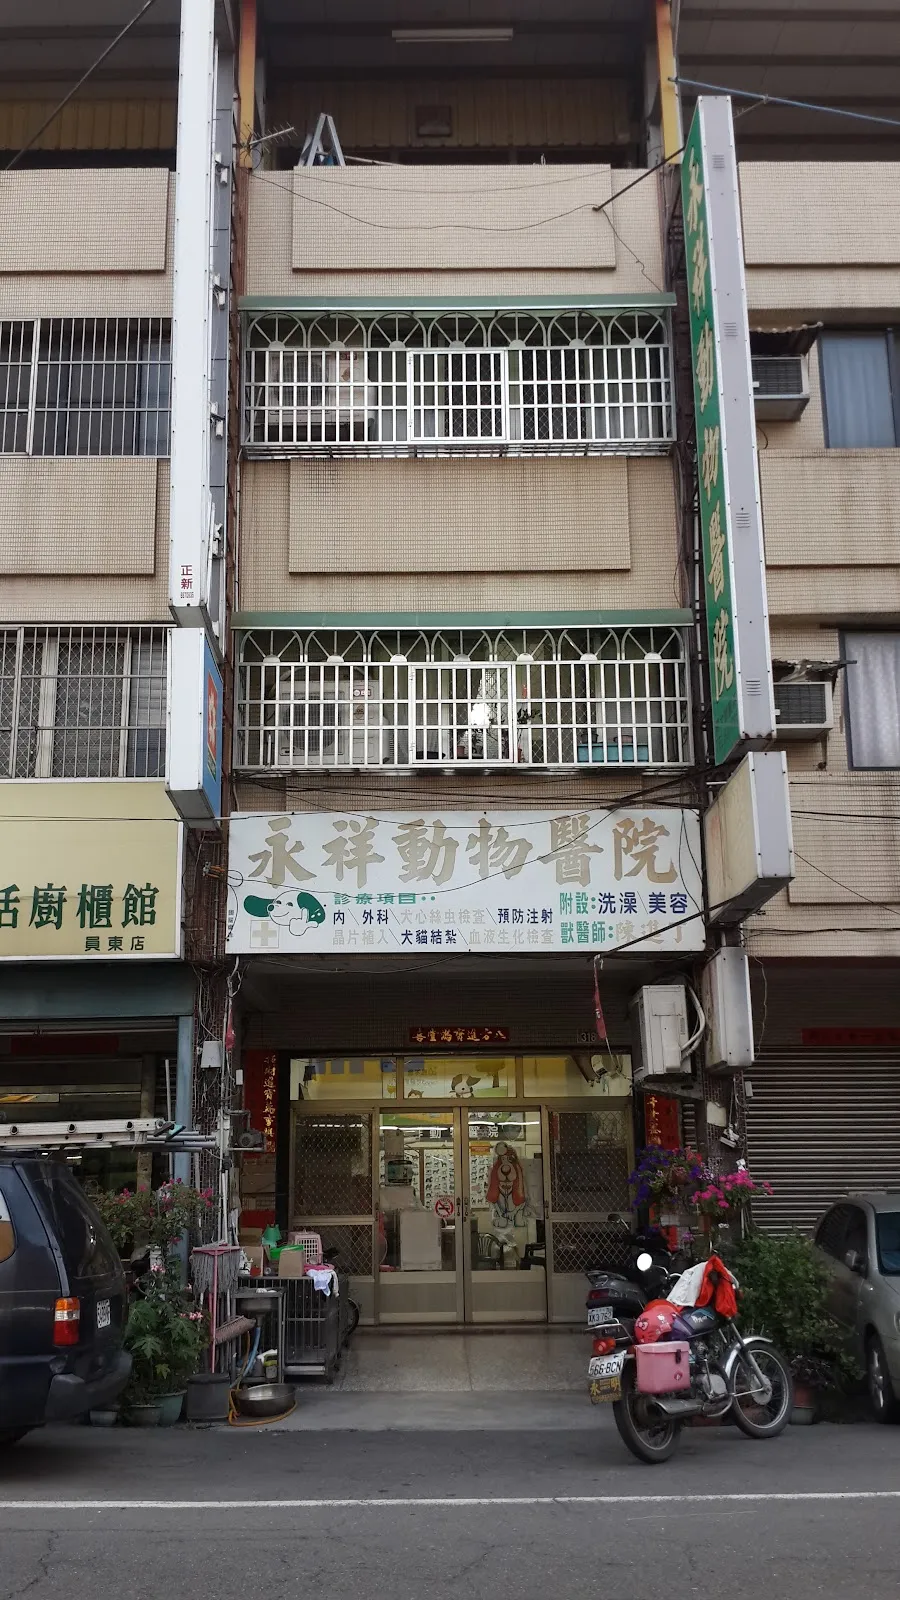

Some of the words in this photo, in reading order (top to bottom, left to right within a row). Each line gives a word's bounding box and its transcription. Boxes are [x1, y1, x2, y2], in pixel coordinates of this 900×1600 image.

[181, 564, 193, 590] 正新
[247, 815, 679, 889] 永祥動物醫院
[598, 892, 638, 915] 洗澡
[648, 892, 688, 914] 美容
[362, 909, 389, 925] 外科
[497, 908, 553, 924] 預防注射
[84, 936, 146, 952] 員東店
[332, 928, 389, 946] 晶片植入
[401, 929, 457, 945] 犬貓結紮
[468, 928, 555, 945] 血液生化檢查
[581, 1032, 597, 1042] 318
